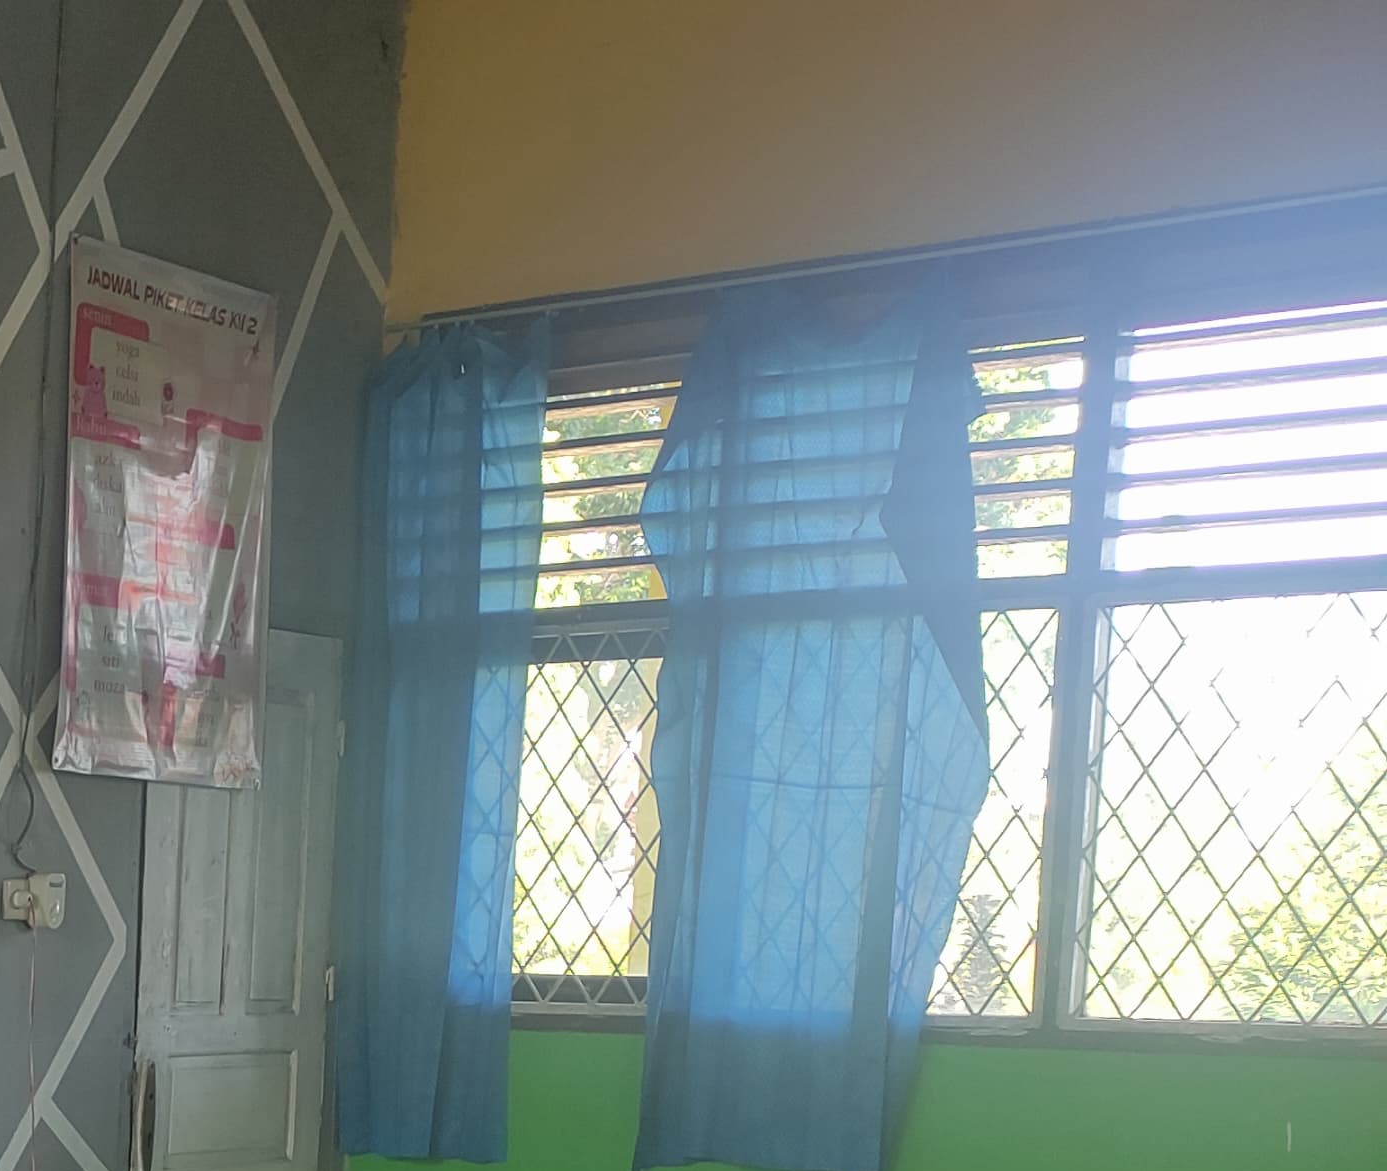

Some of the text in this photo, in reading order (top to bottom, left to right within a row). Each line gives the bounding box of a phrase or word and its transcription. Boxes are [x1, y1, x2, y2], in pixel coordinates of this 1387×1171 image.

[87, 265, 140, 301] JADWAL
[143, 285, 184, 313] PIKET
[246, 317, 258, 335] 2
